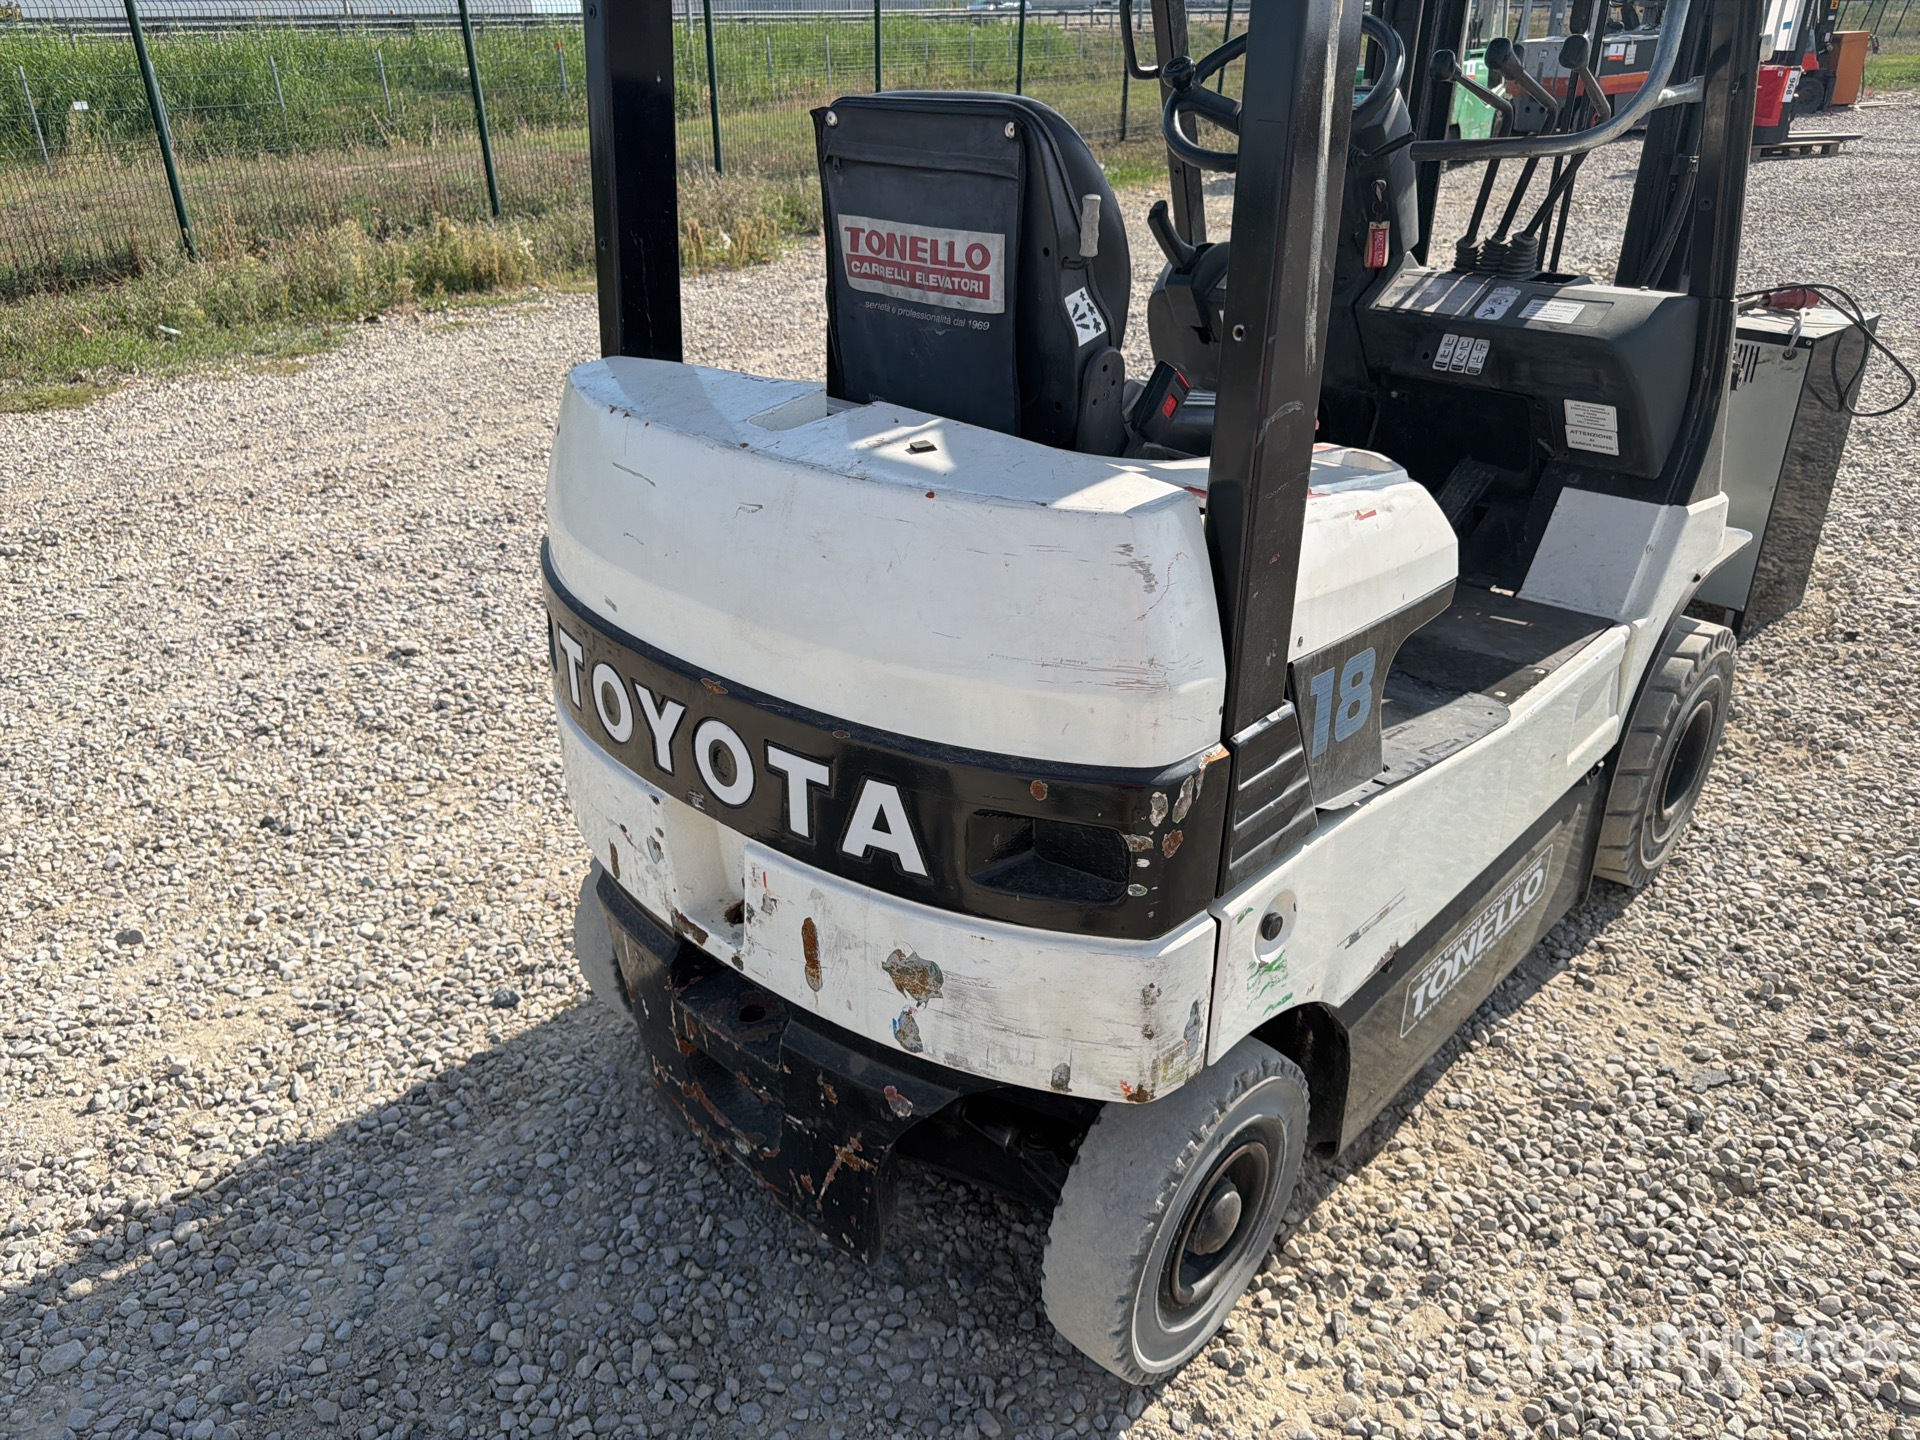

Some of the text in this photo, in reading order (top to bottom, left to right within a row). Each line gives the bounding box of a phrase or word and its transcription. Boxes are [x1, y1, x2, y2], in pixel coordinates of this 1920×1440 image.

[844, 226, 991, 271] TONELLO
[851, 261, 984, 293] CARRELLI ELEVATORI
[897, 308, 952, 325] professionalità
[953, 315, 966, 328] dal
[967, 319, 990, 331] 1969
[1570, 429, 1613, 441] ATTENZIONE
[1310, 646, 1376, 759] 18
[558, 625, 930, 878] TOYOTA
[1411, 867, 1545, 1018] TONELLO
[1420, 917, 1482, 982] SOLUZIONI
[1483, 857, 1544, 920] LOGISTICHE
